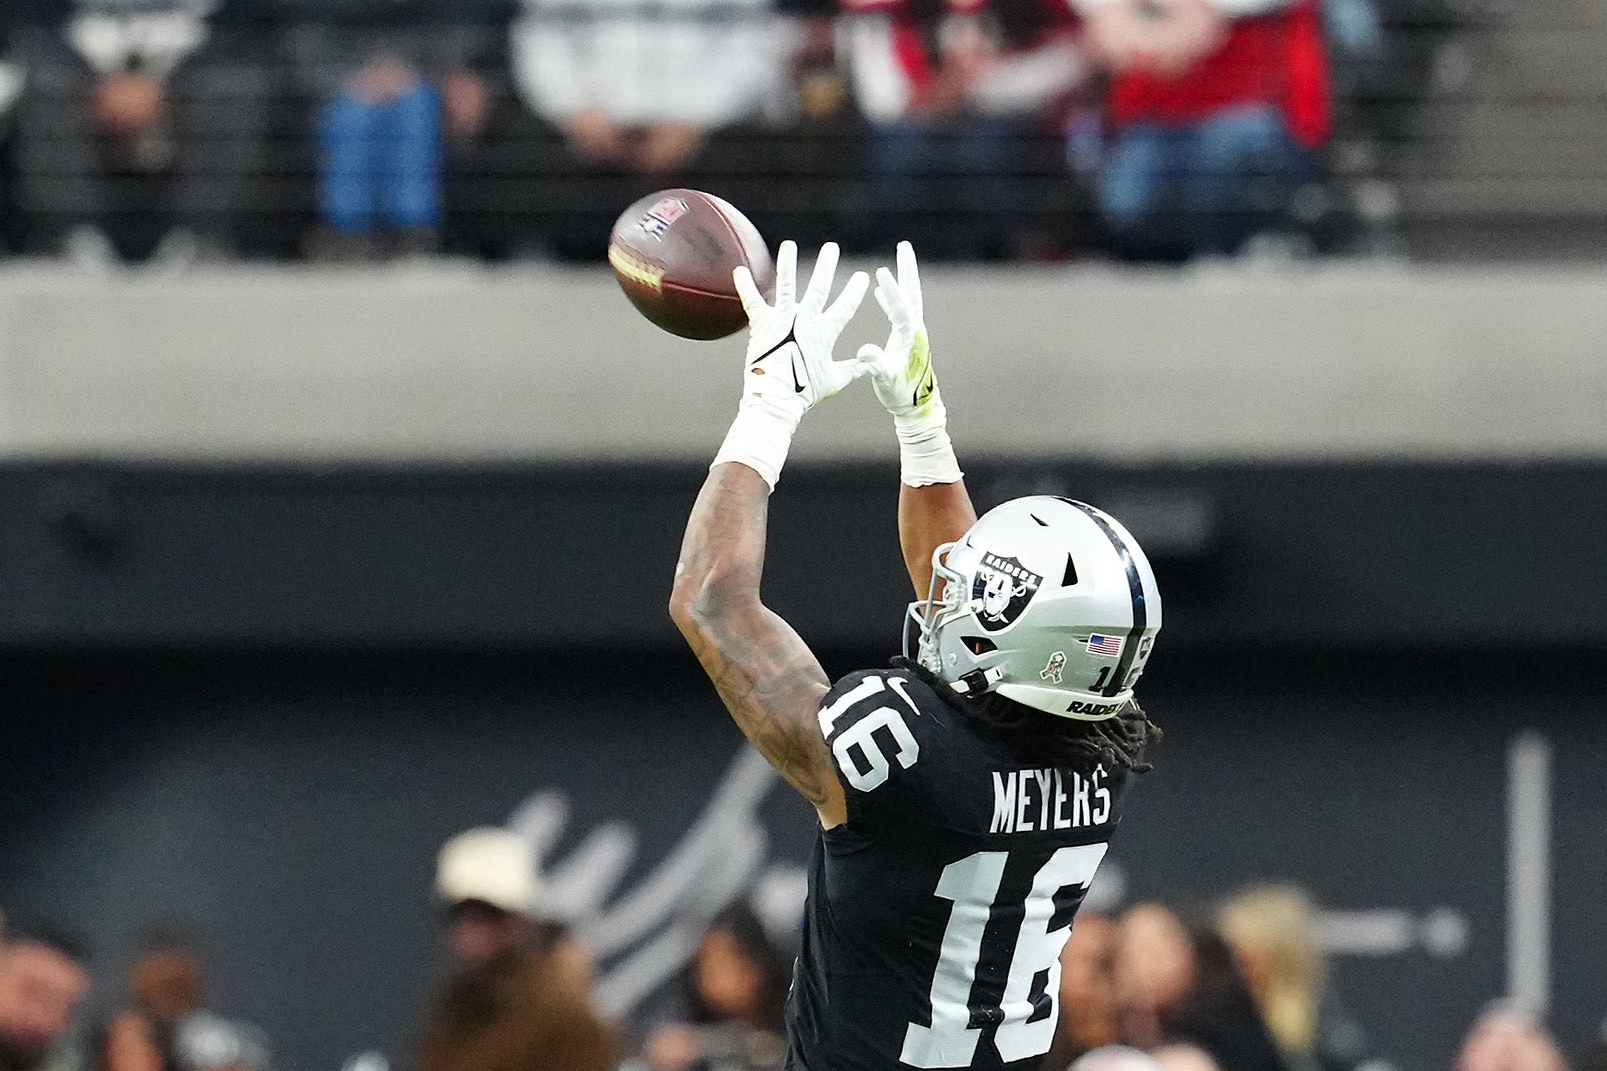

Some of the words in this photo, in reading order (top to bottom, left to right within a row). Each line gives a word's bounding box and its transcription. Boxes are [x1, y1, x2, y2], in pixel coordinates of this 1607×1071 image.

[817, 675, 920, 792] 16
[989, 763, 1111, 834] MEYERS
[899, 842, 1109, 1069] 16
